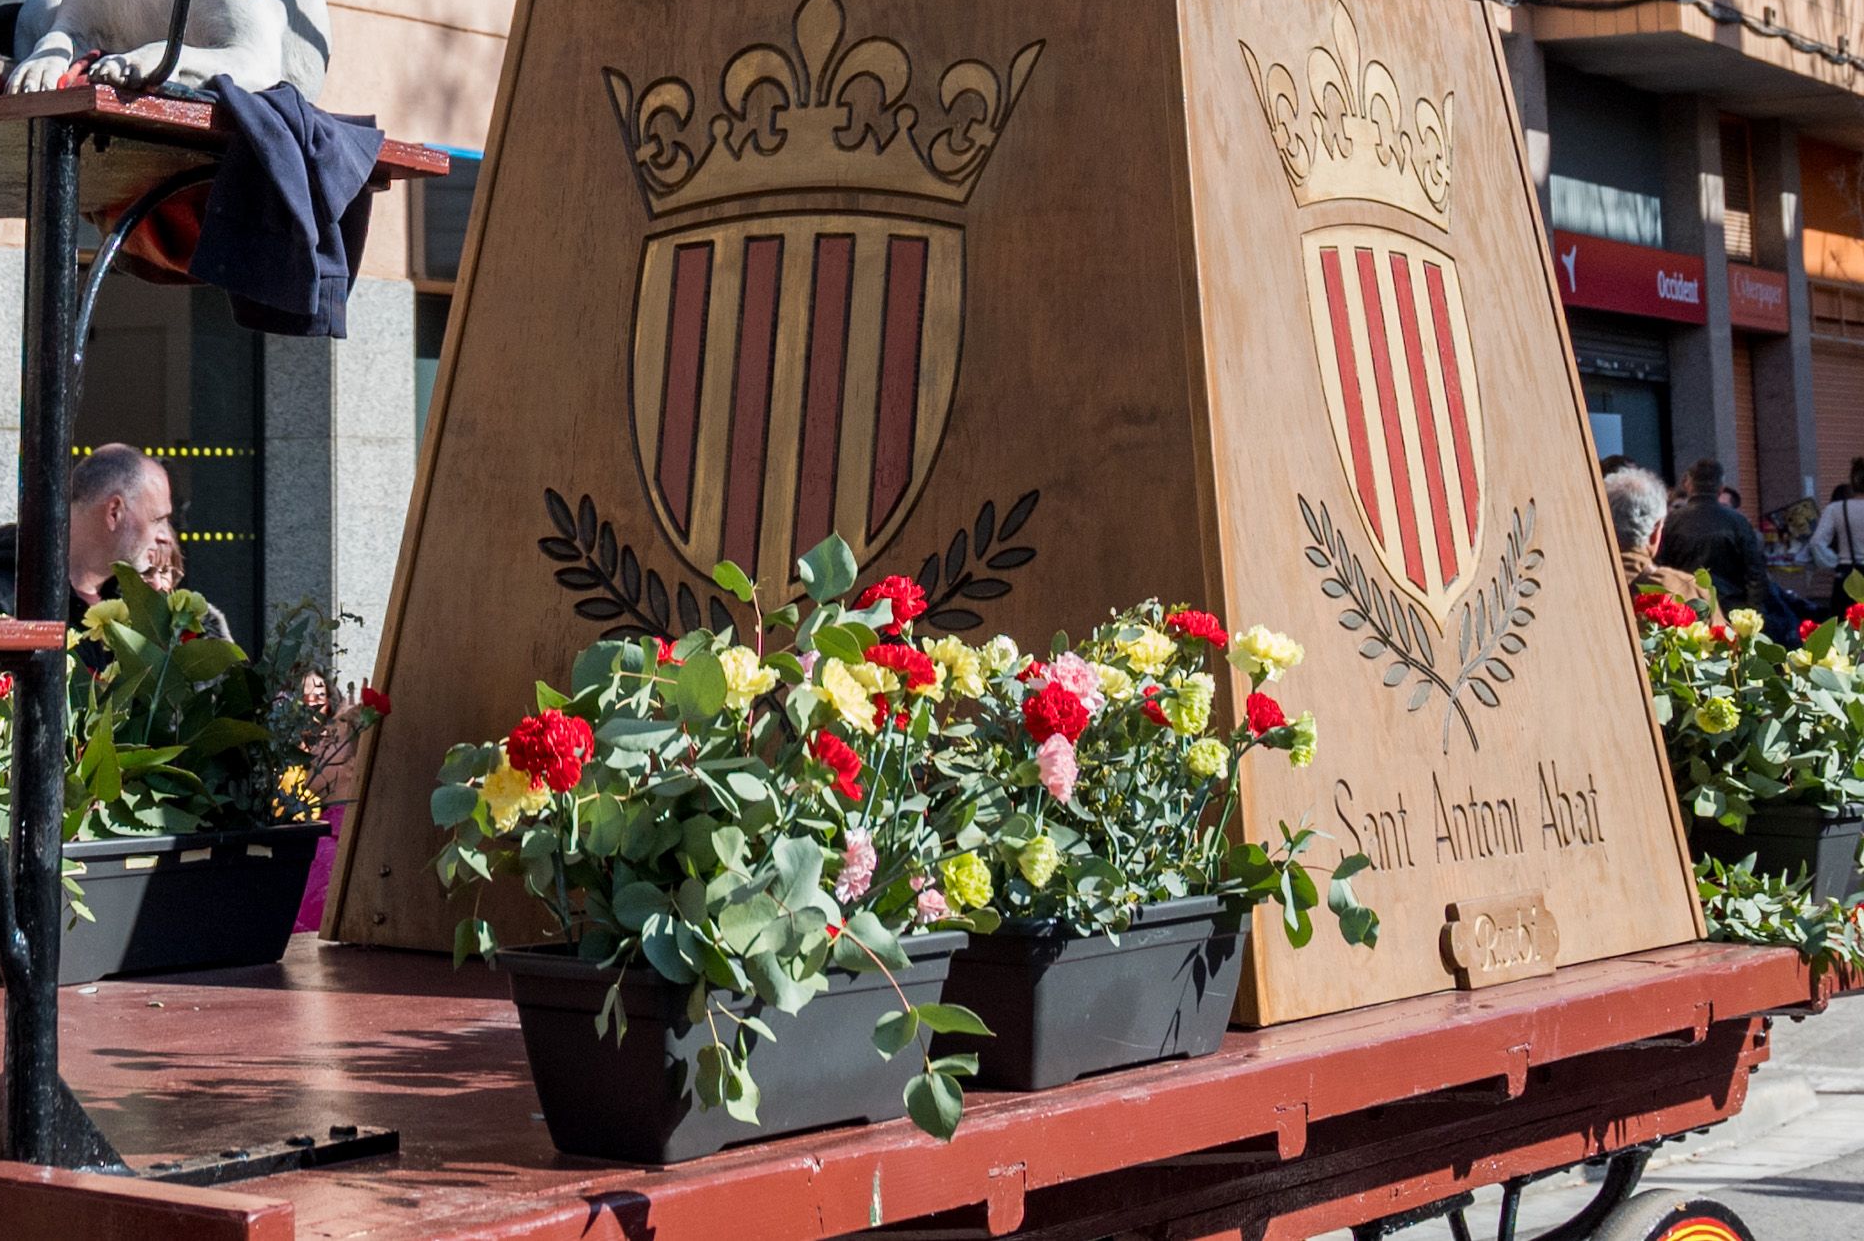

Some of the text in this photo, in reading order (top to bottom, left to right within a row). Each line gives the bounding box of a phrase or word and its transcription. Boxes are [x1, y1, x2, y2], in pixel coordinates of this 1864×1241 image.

[1657, 270, 1700, 304] Occident
[1334, 759, 1605, 871] Sant Antoni Abat
